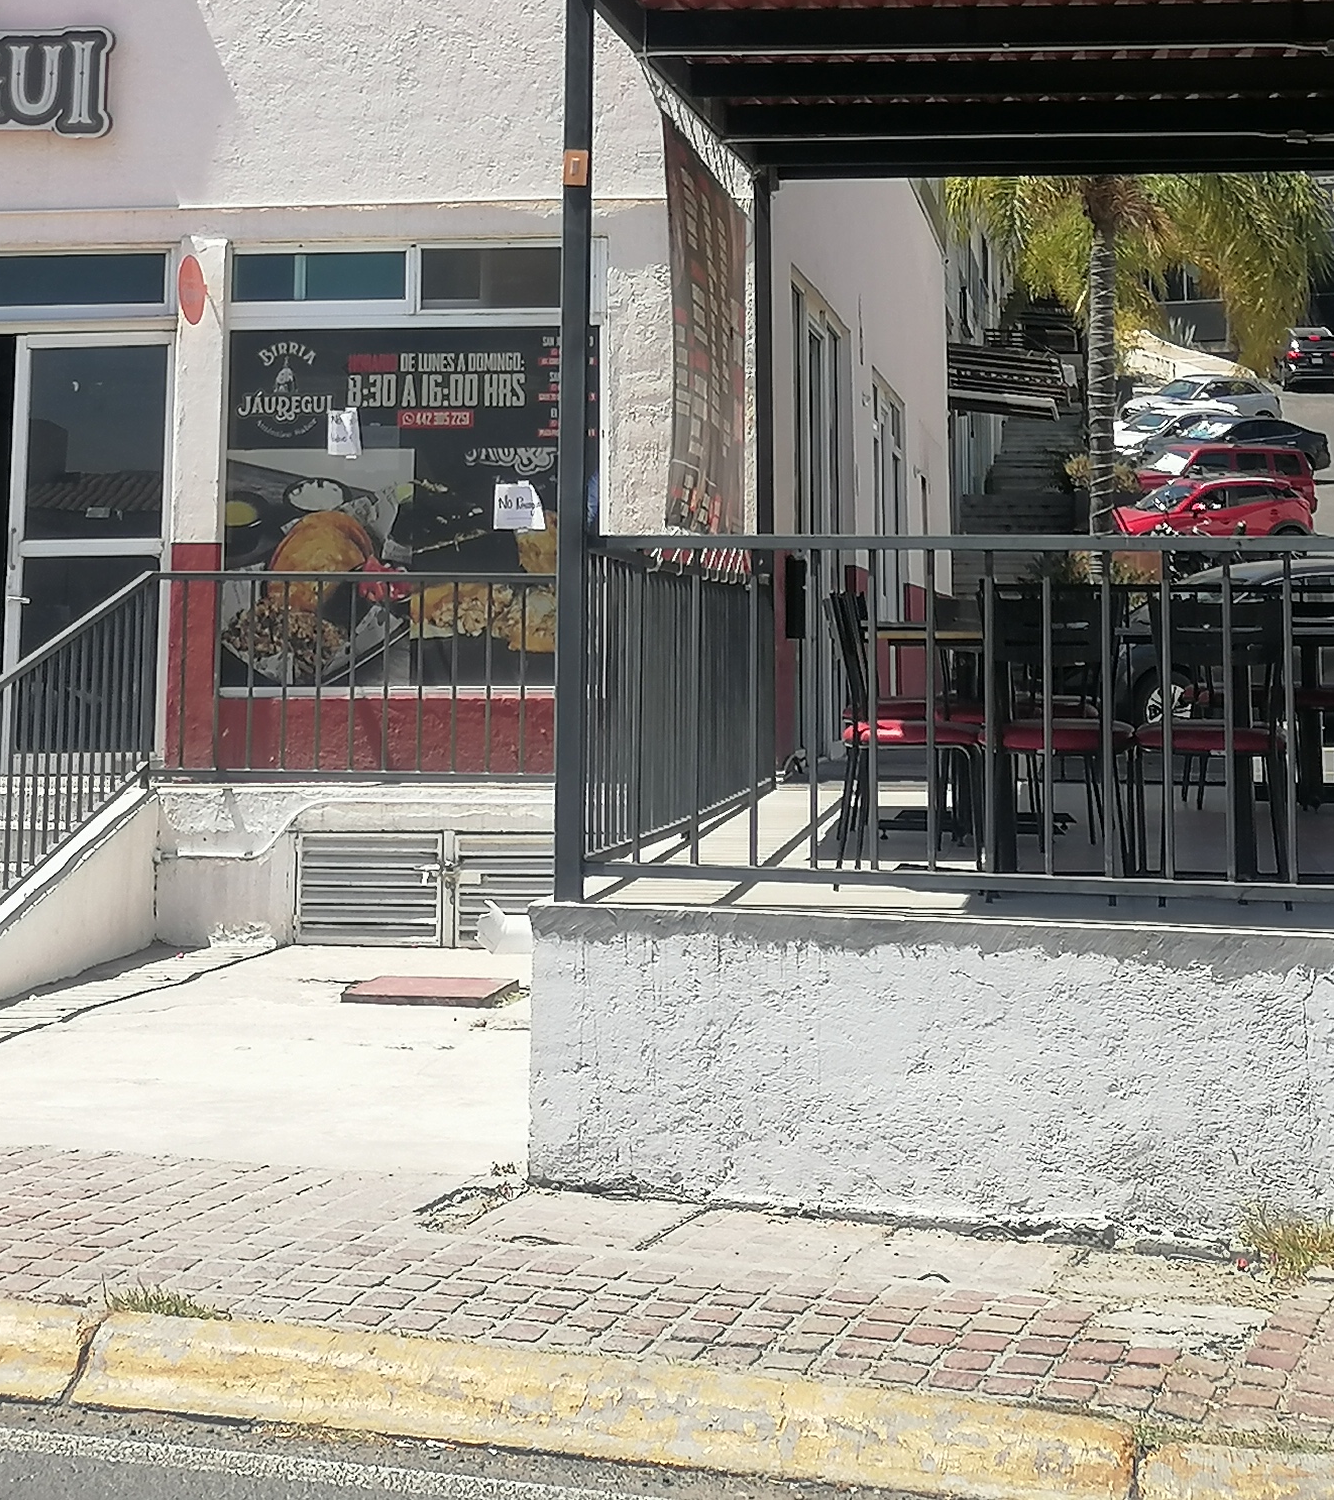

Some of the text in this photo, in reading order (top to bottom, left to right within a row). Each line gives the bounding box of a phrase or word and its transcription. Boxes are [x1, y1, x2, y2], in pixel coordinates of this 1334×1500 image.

[258, 341, 317, 367] BIRRIA
[400, 352, 416, 372] DE
[417, 352, 456, 372] LUNES
[456, 352, 467, 372] A
[347, 372, 526, 408] 8:30 A 16:00 HRS
[237, 391, 334, 421] JÁUREGUI
